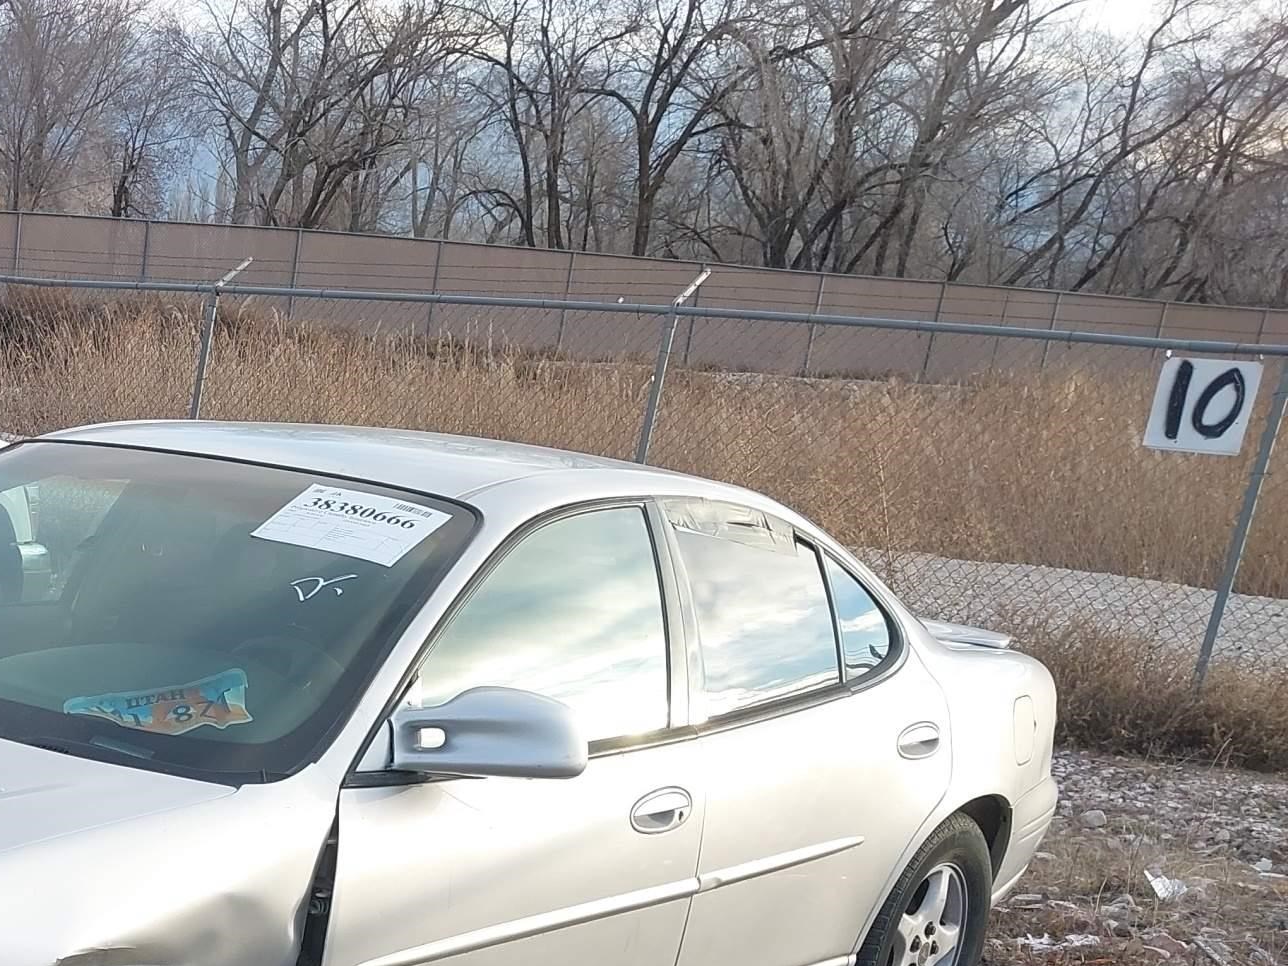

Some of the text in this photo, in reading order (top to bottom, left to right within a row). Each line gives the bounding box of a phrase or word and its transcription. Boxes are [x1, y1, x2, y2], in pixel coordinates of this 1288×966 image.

[1164, 359, 1246, 441] 10
[303, 497, 421, 529] 38380666
[126, 689, 187, 709] UTAH
